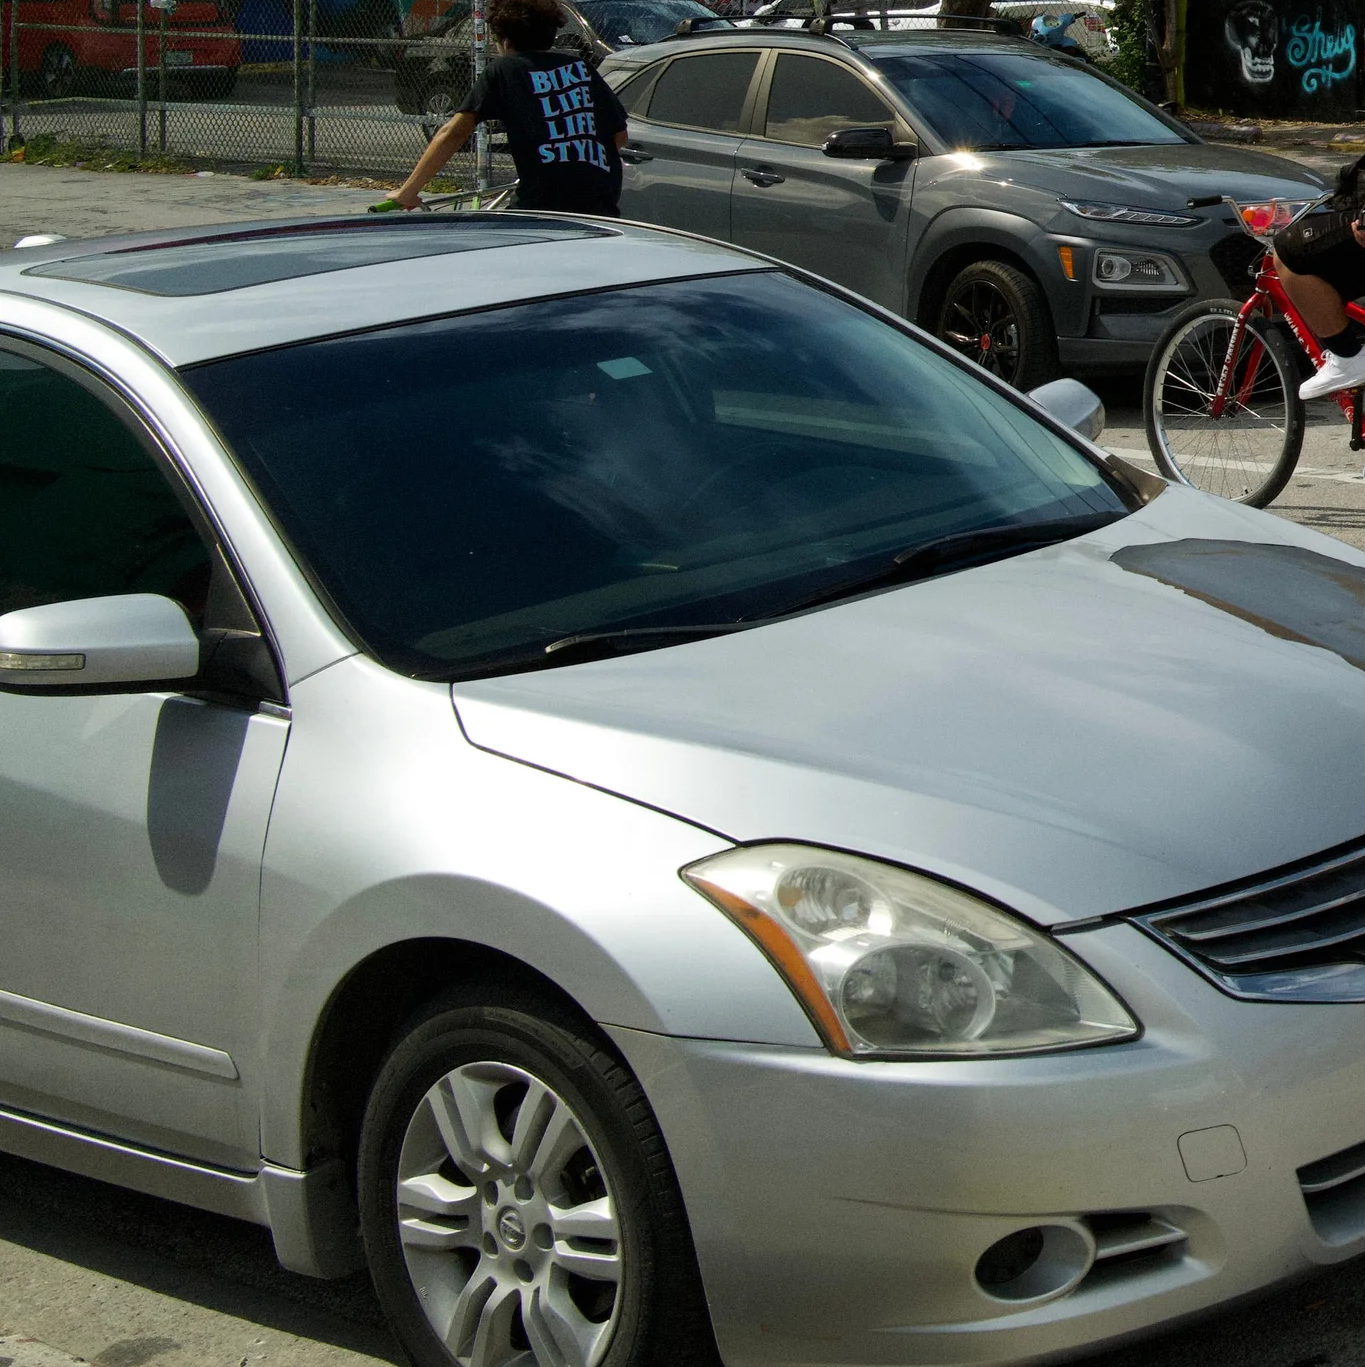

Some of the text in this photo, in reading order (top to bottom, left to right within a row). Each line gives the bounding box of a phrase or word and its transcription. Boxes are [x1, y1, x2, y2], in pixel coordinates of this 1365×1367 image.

[528, 60, 592, 94] BIKE
[538, 86, 595, 118] LIFE
[545, 112, 597, 140] LIFE
[537, 138, 611, 173] STYLE
